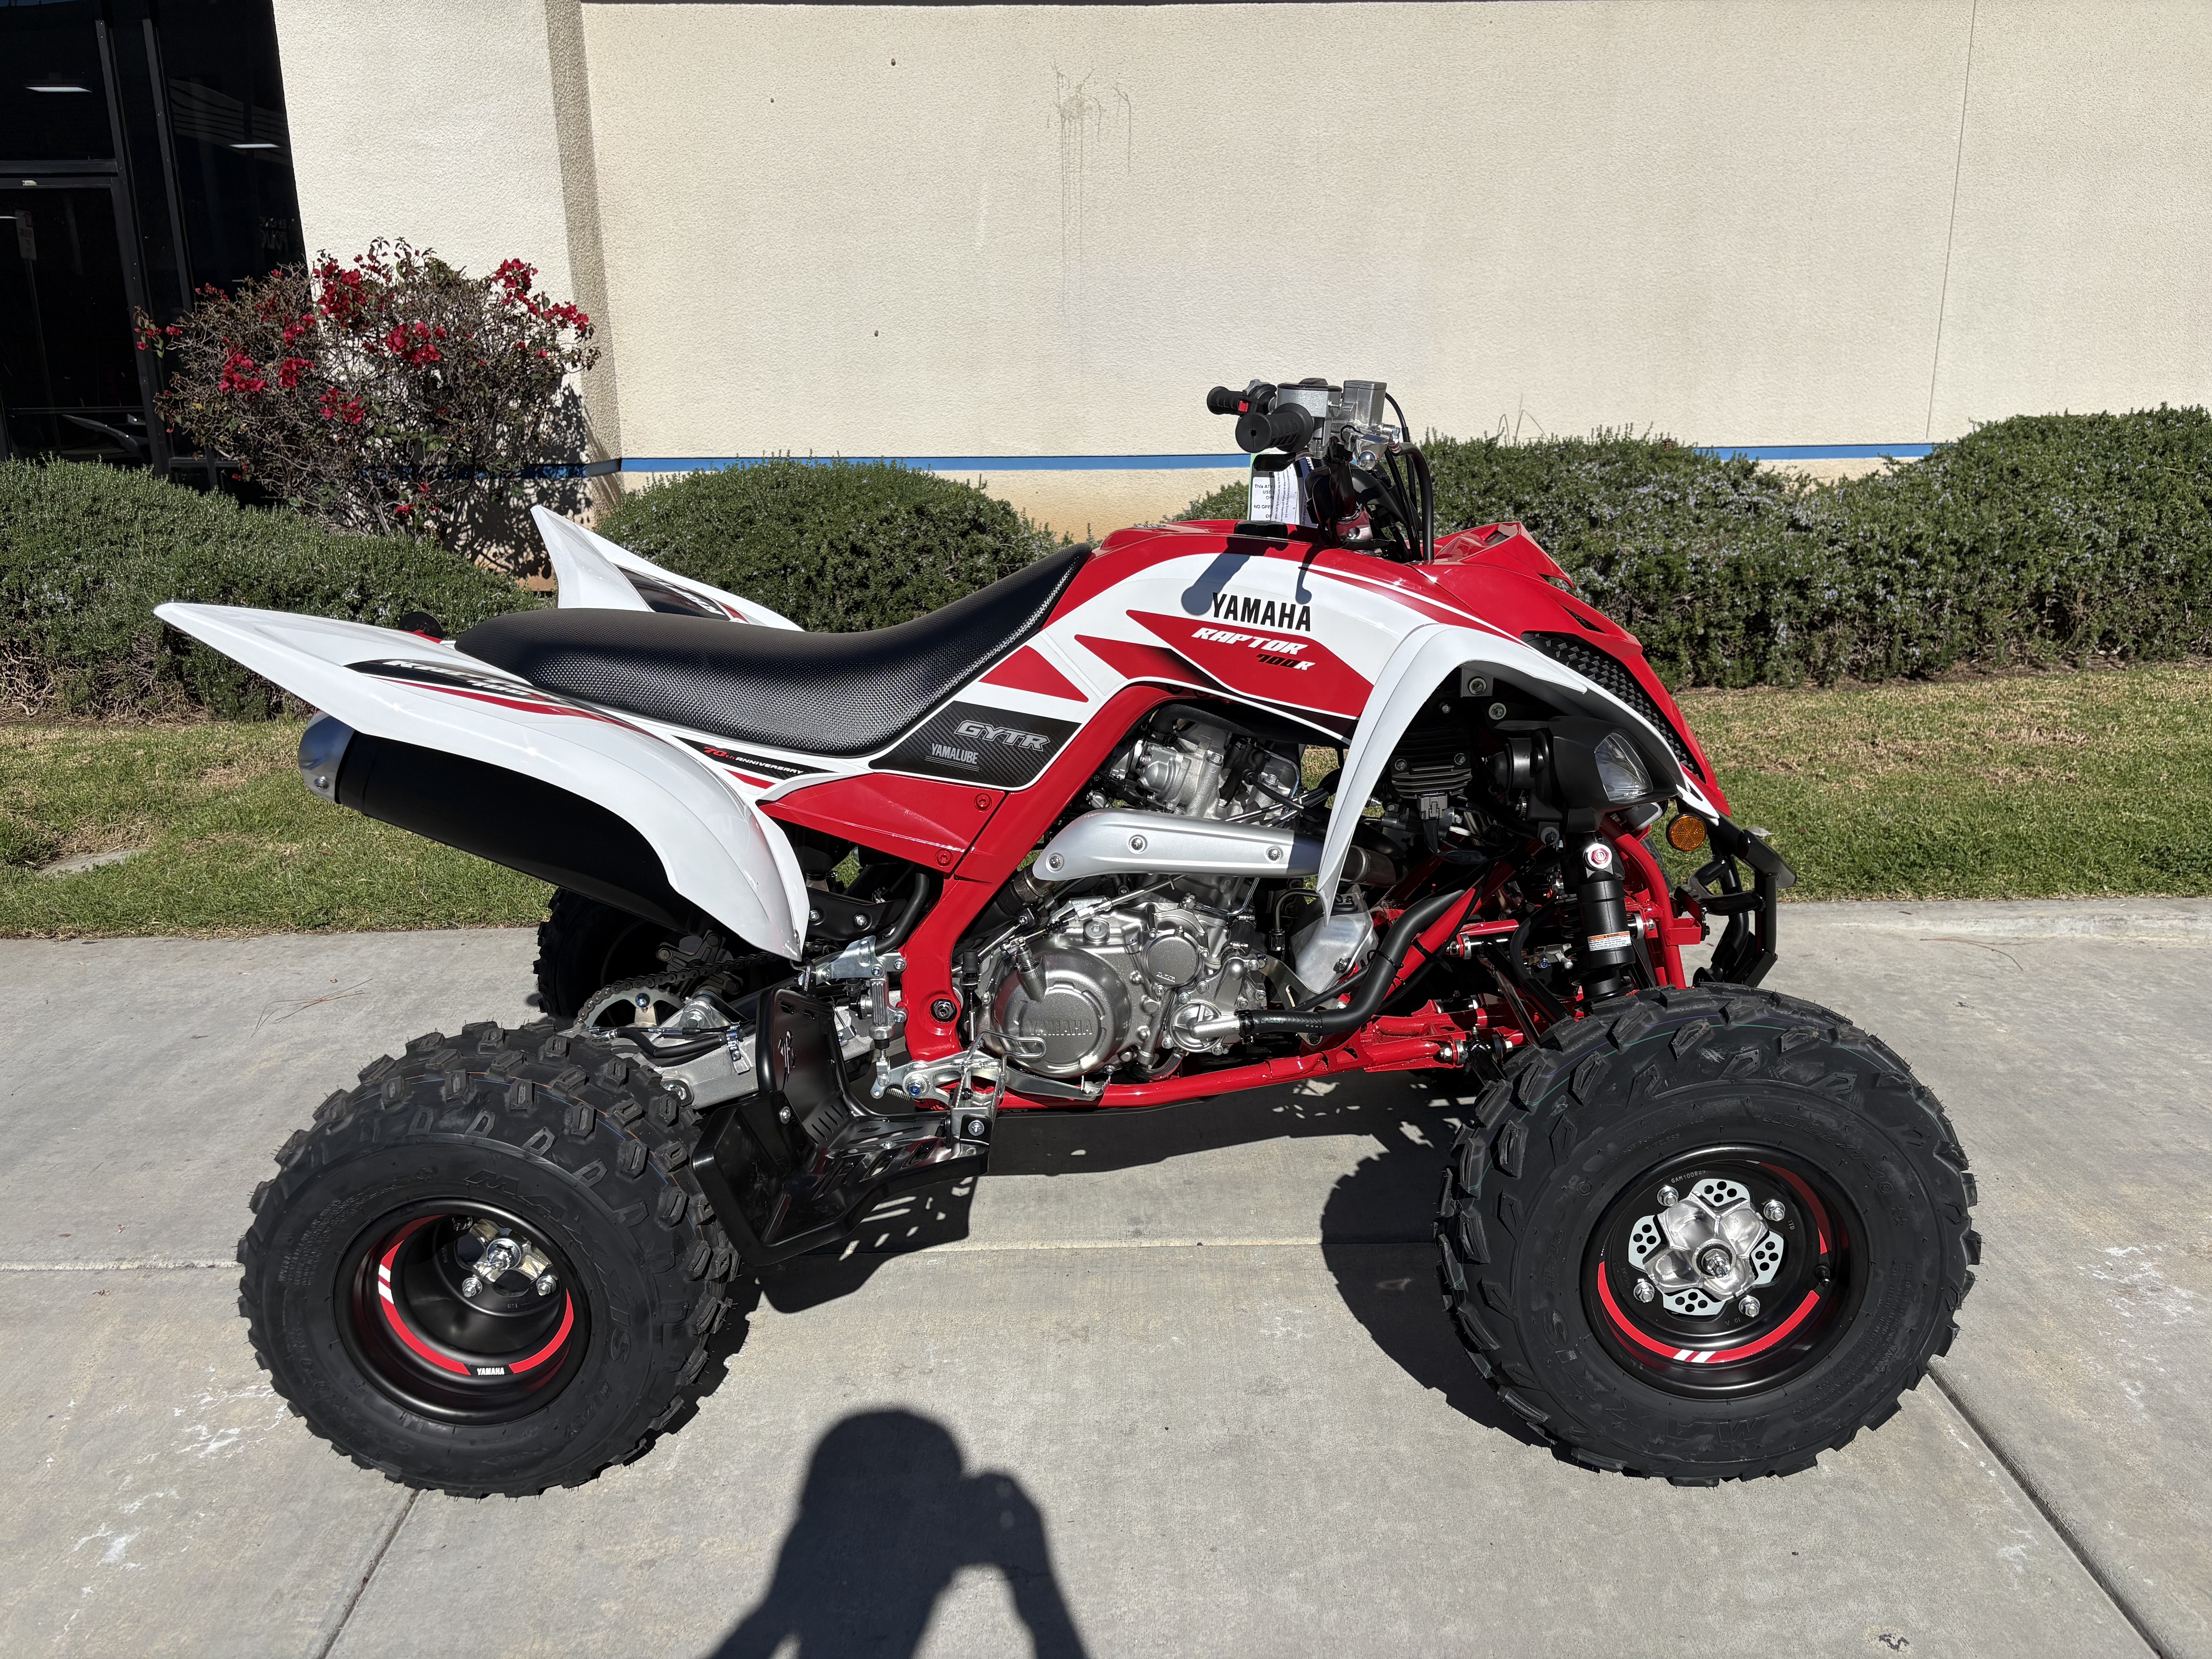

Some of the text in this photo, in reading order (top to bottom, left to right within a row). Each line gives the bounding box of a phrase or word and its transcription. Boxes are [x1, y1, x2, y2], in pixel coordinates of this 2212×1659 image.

[1212, 592, 1311, 632] YAMAHA
[1191, 627, 1309, 655] RAPTOR
[1256, 653, 1316, 671] 700R
[953, 720, 1051, 752] GYTR
[735, 757, 804, 774] ANNIVERSARY
[931, 743, 979, 765] YAMALUBE
[1622, 1143, 1636, 1155] NOT
[1655, 1121, 1685, 1137] HIGHWAY
[1689, 1116, 1705, 1124] USE
[1645, 1133, 1681, 1151] TUBELESS
[477, 1367, 505, 1376] YAMAHA
[1542, 1310, 1771, 1444] MAXXIS
